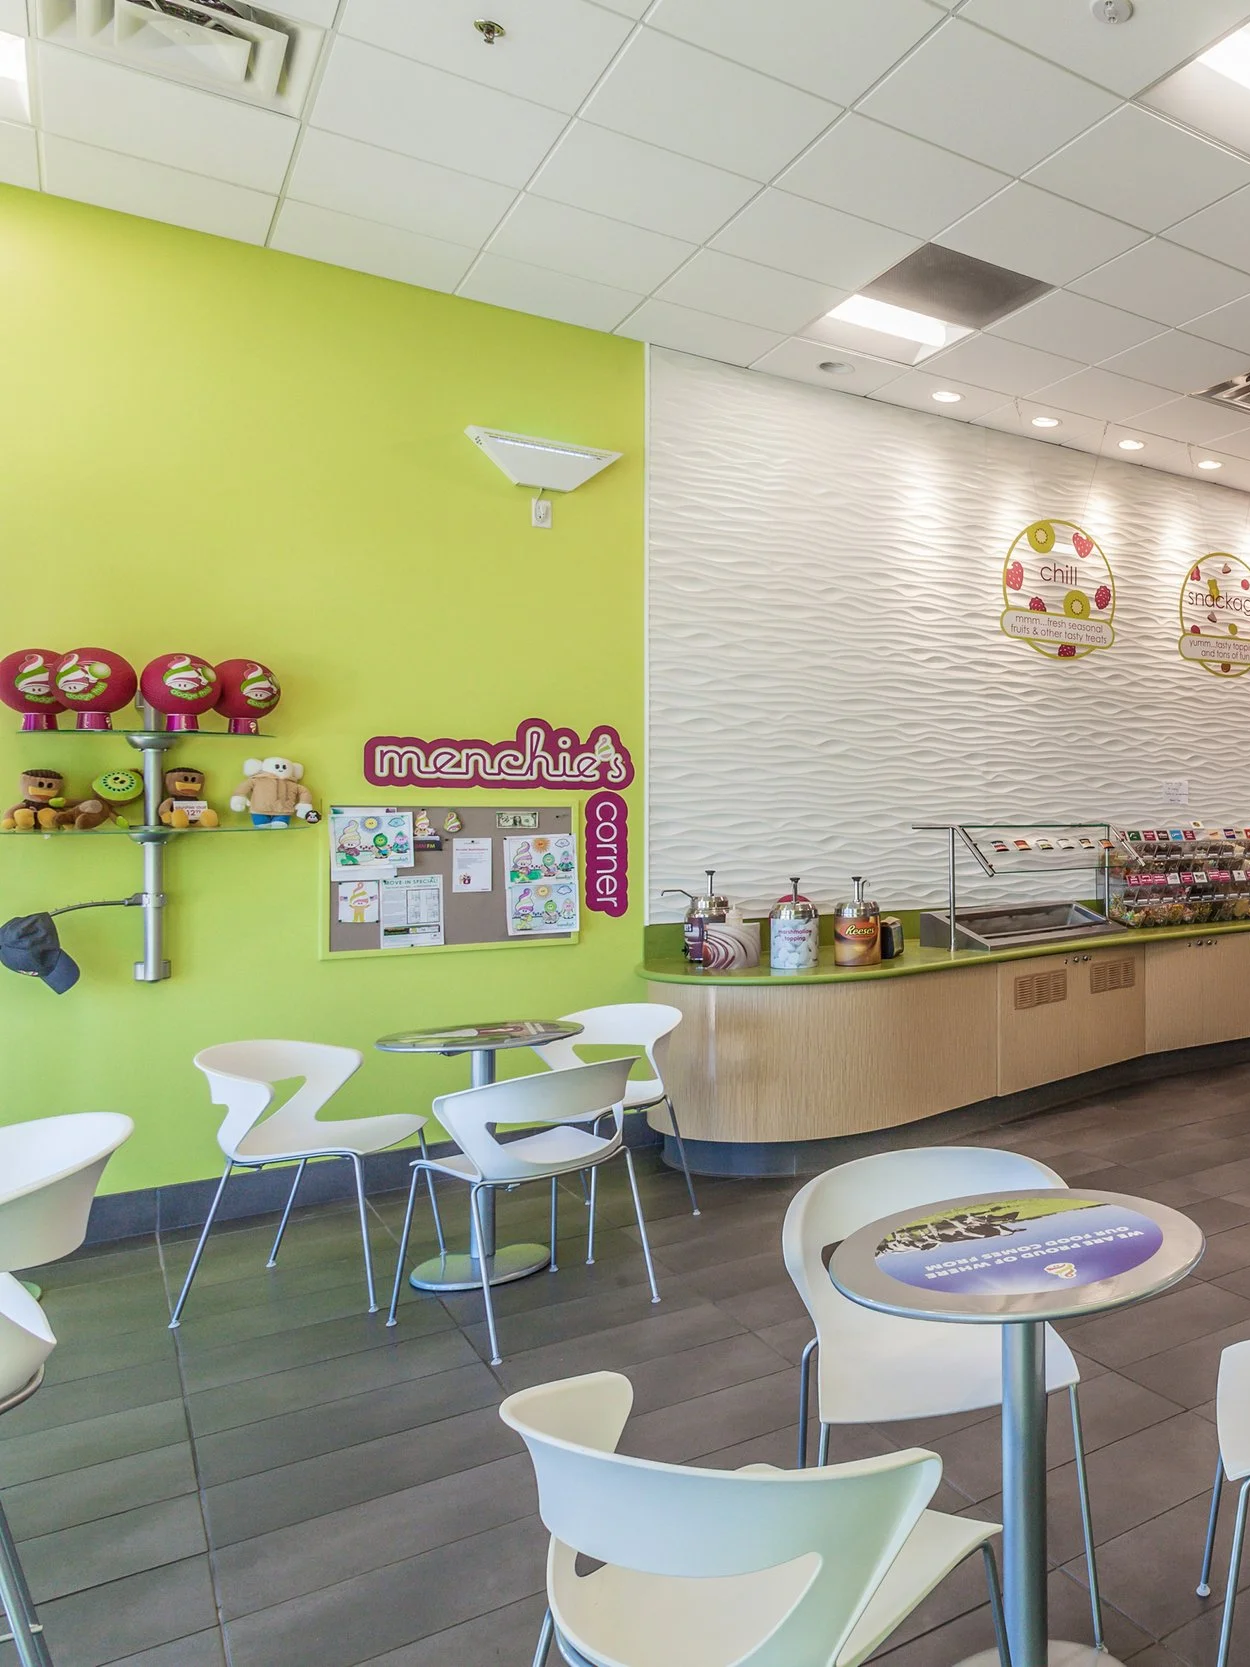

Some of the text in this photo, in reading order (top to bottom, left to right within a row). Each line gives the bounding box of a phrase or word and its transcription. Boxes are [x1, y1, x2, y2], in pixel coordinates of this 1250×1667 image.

[1040, 562, 1079, 586] chill
[1010, 624, 1108, 645] fruits & other tasty treats
[1015, 614, 1104, 634] mmm...fresh seasonal
[1189, 638, 1232, 652] yumm...tasty
[1201, 648, 1250, 661] and tons of fun
[375, 726, 627, 783] menchie's
[594, 801, 619, 908] corner
[925, 1226, 1130, 1271] OUR FOOD COMES FROM
[925, 1229, 1145, 1280] WE ARE PROUD OF WHERE
